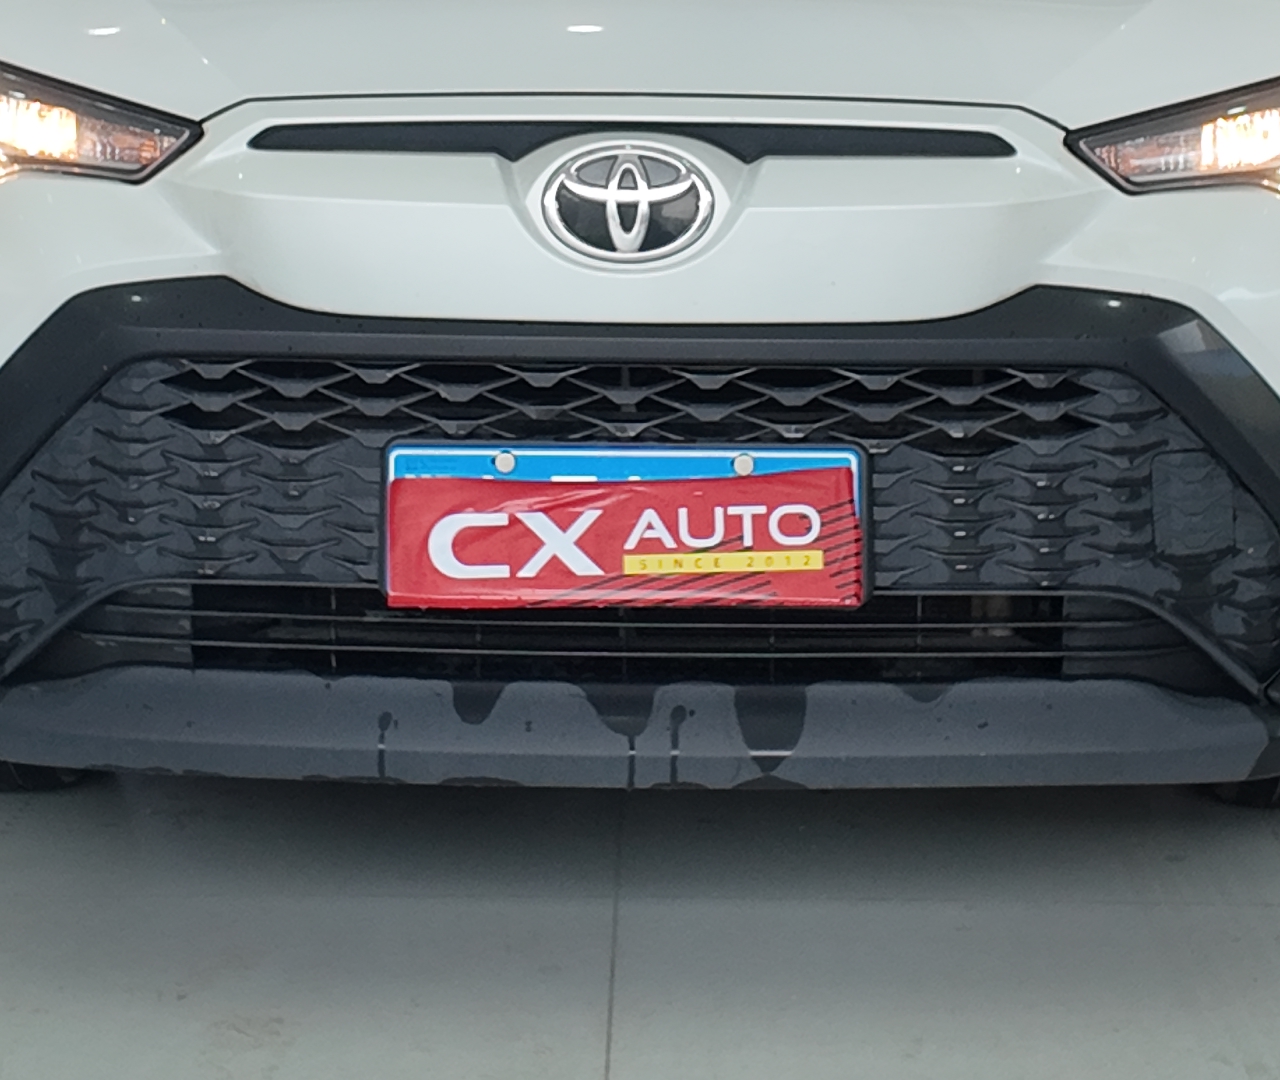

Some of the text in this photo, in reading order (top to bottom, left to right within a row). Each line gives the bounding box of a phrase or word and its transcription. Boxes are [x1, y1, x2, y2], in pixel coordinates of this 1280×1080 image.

[427, 504, 822, 580] CX AUTO
[639, 555, 812, 571] SINCE 2012
